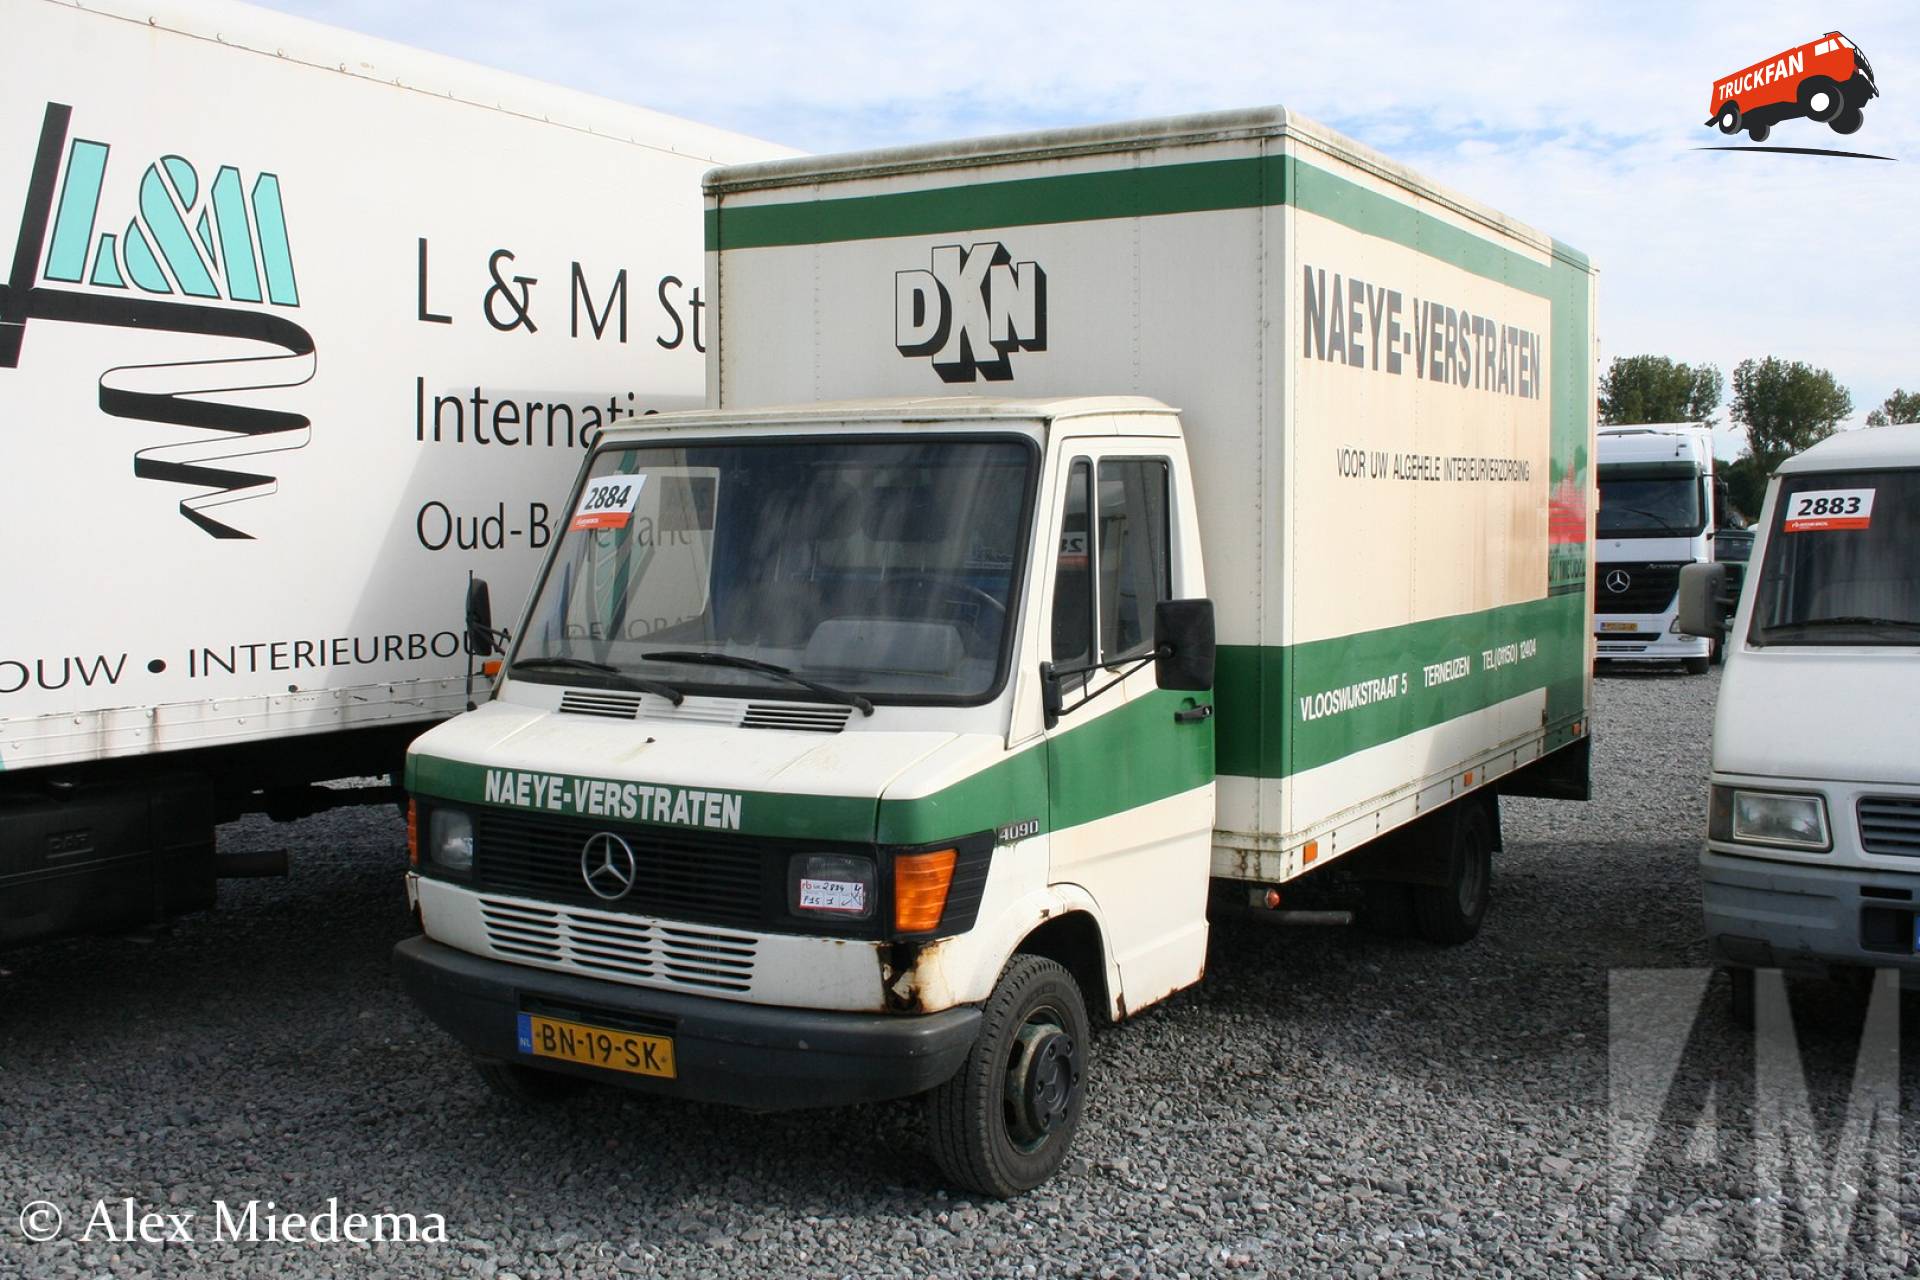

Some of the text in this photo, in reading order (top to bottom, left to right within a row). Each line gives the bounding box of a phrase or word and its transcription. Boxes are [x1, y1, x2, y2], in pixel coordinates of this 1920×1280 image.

[418, 237, 452, 325] L
[484, 248, 538, 334] &
[571, 261, 627, 343] M
[896, 242, 1047, 383] DKN
[1303, 264, 1540, 400] NAEYE-VERSTRATEN
[1336, 447, 1530, 482] VOOR UW ALGEHELE INTERIEURVERZORGING
[584, 485, 632, 511] 2884
[1798, 496, 1862, 517] 2883
[1300, 674, 1399, 721] VLOOSWIJKSTRAAT
[1401, 672, 1408, 694] 5
[1423, 656, 1471, 687] TERNEUZEN
[485, 769, 742, 830] NAEYE-VERSTRATEN
[1000, 820, 1039, 841] 4090
[519, 1037, 531, 1048] NL
[541, 1023, 662, 1071] BN-19-SK
